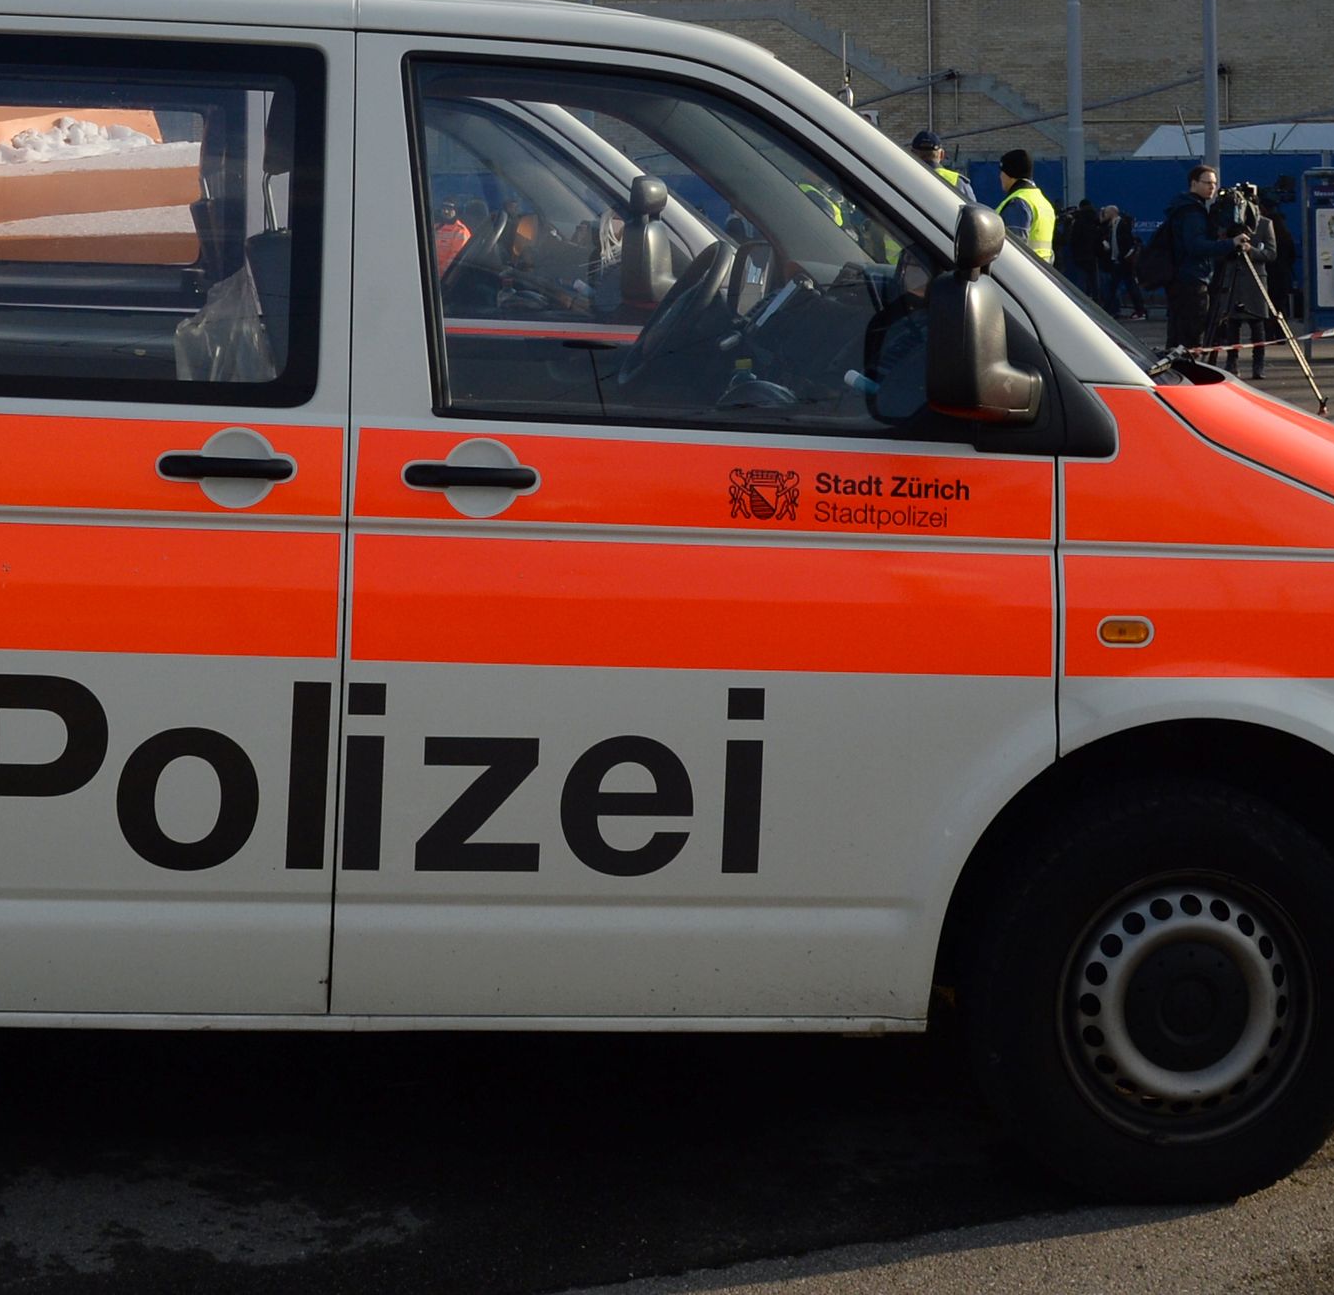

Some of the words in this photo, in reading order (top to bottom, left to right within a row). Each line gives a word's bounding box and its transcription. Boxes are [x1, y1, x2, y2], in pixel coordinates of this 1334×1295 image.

[814, 472, 883, 497] Stadt
[890, 476, 970, 500] Zürich
[814, 501, 948, 529] Stadtpolizei
